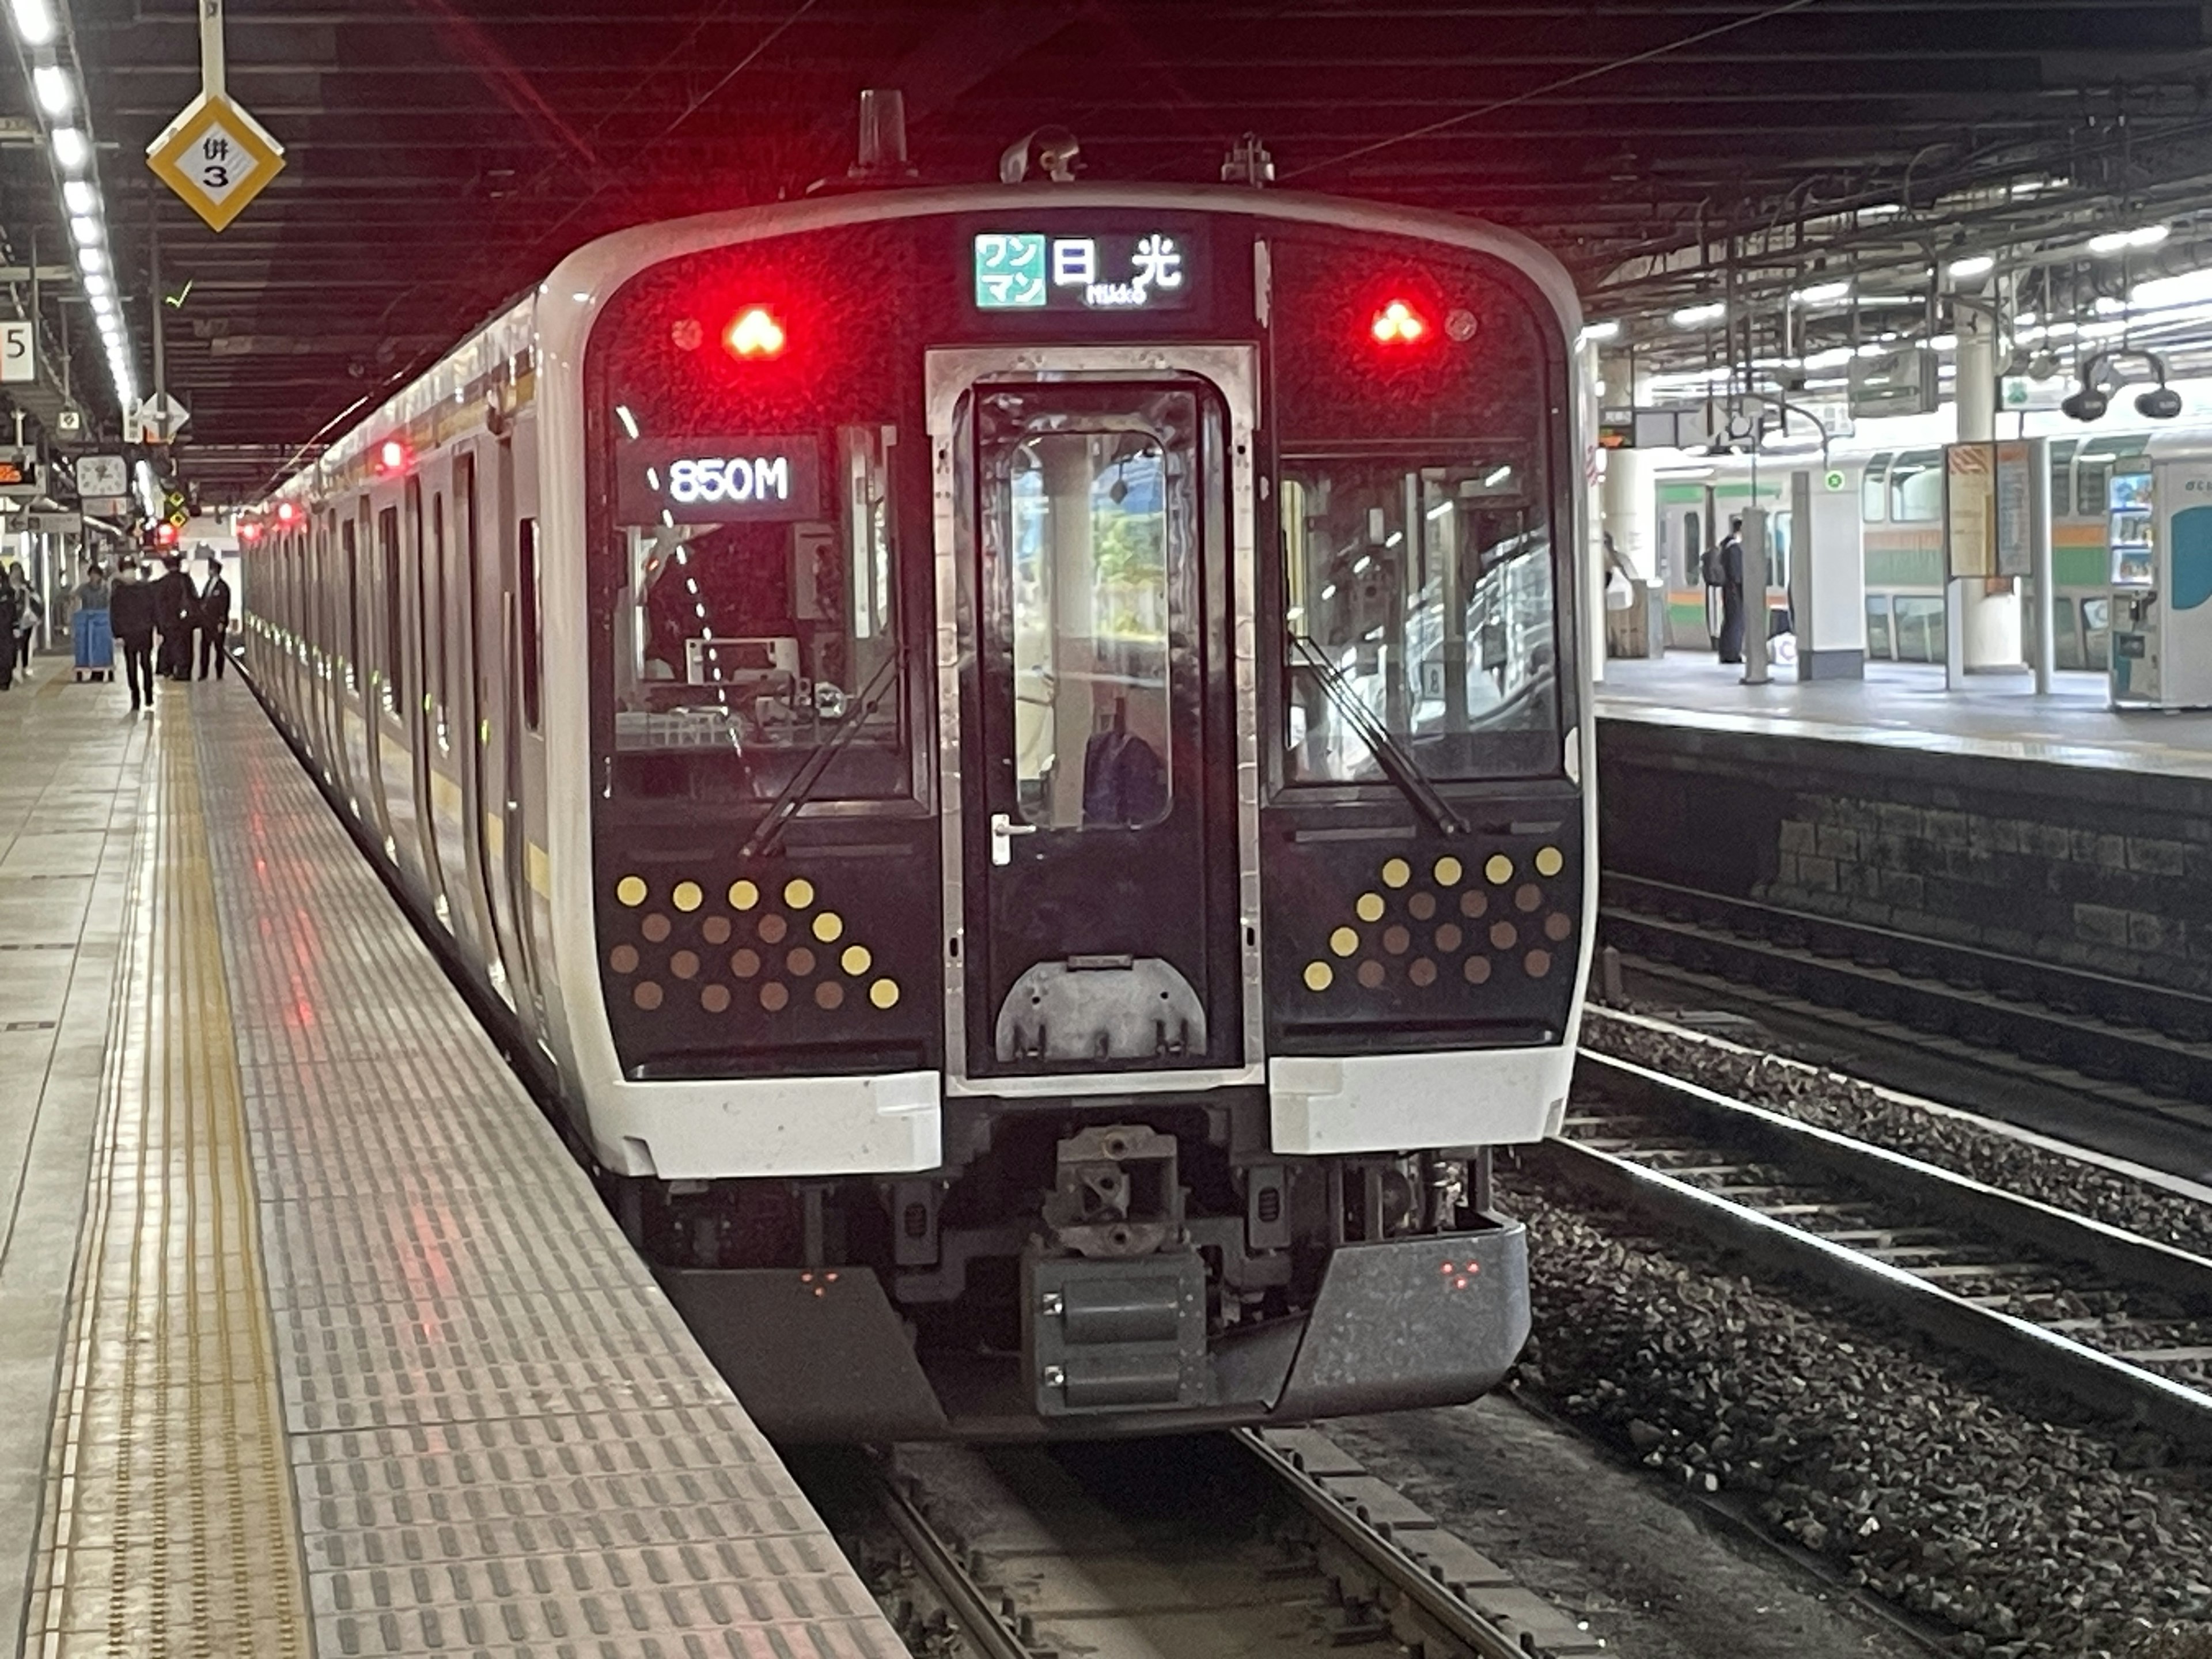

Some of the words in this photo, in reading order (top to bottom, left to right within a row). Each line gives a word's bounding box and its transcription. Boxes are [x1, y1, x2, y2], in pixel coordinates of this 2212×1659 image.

[203, 165, 228, 187] 3
[975, 236, 1037, 268] ワン
[1054, 234, 1181, 286] 日光
[980, 272, 1043, 303] マン
[7, 329, 25, 358] 5
[669, 457, 787, 502] 850M
